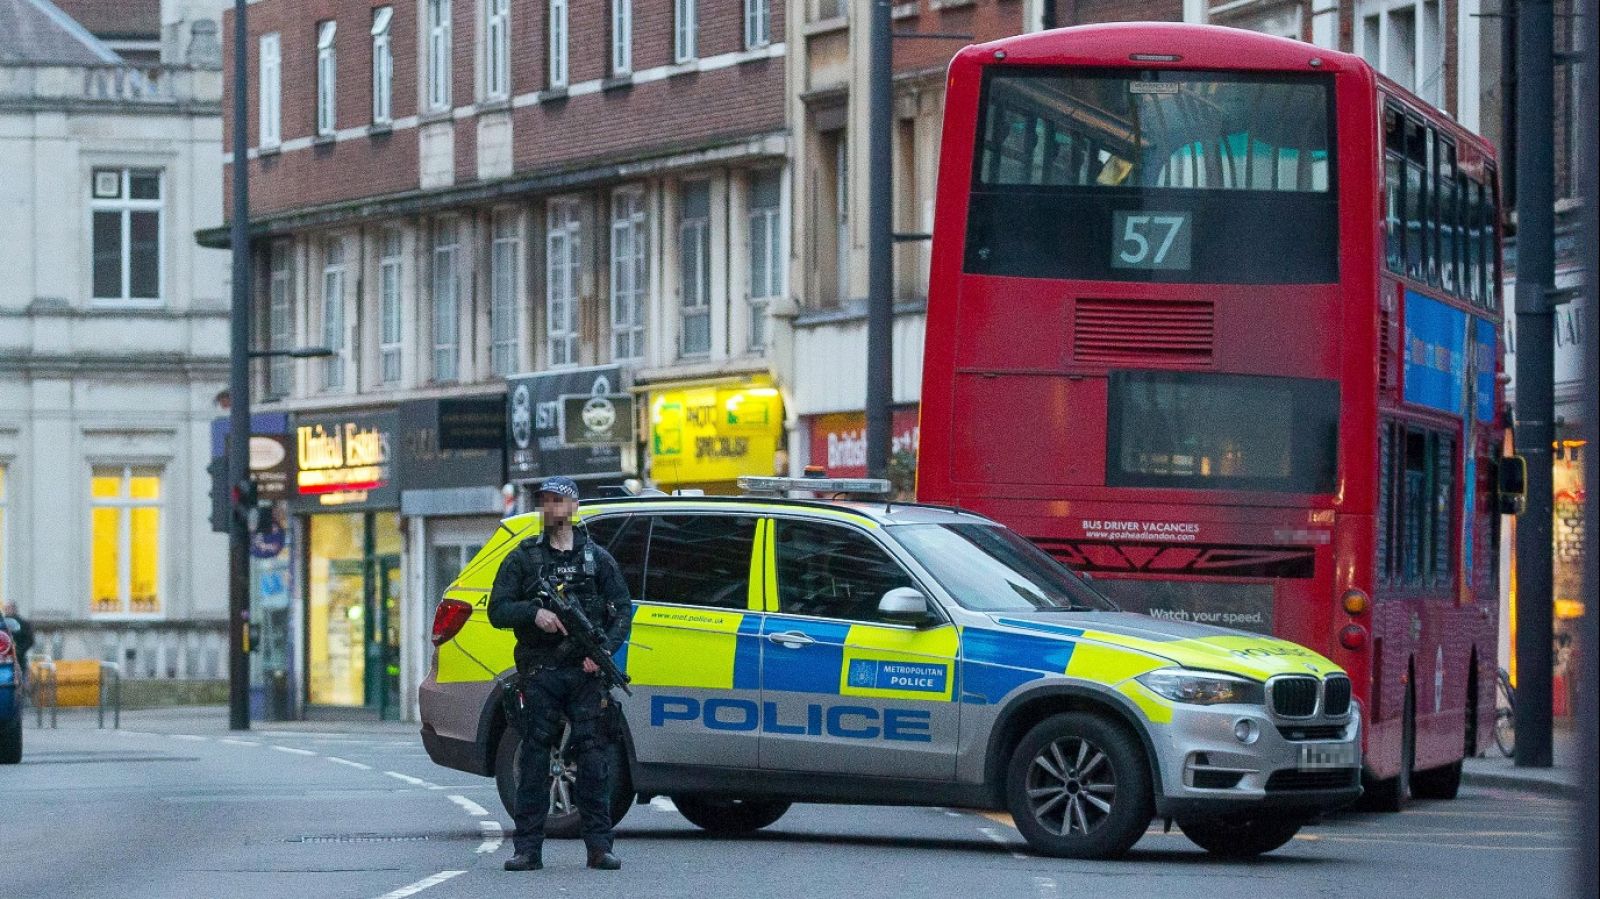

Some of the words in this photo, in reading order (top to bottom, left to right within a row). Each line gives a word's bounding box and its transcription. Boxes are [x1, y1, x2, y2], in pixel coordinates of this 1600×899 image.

[1120, 215, 1184, 264] 57
[1082, 520, 1102, 530] BUS
[1104, 521, 1139, 531] DRIVER
[1142, 522, 1200, 532] VACANCIES
[1086, 530, 1195, 541] www.goaheadlondon.com
[557, 566, 577, 574] POLICE
[651, 611, 725, 625] www.met.police.uk
[1149, 608, 1189, 621] Watch
[1192, 611, 1222, 622] your
[1223, 611, 1264, 624] speed.
[883, 664, 944, 677] METROPOLITAN
[890, 675, 935, 688] POLICE
[650, 694, 932, 743] POLICE
